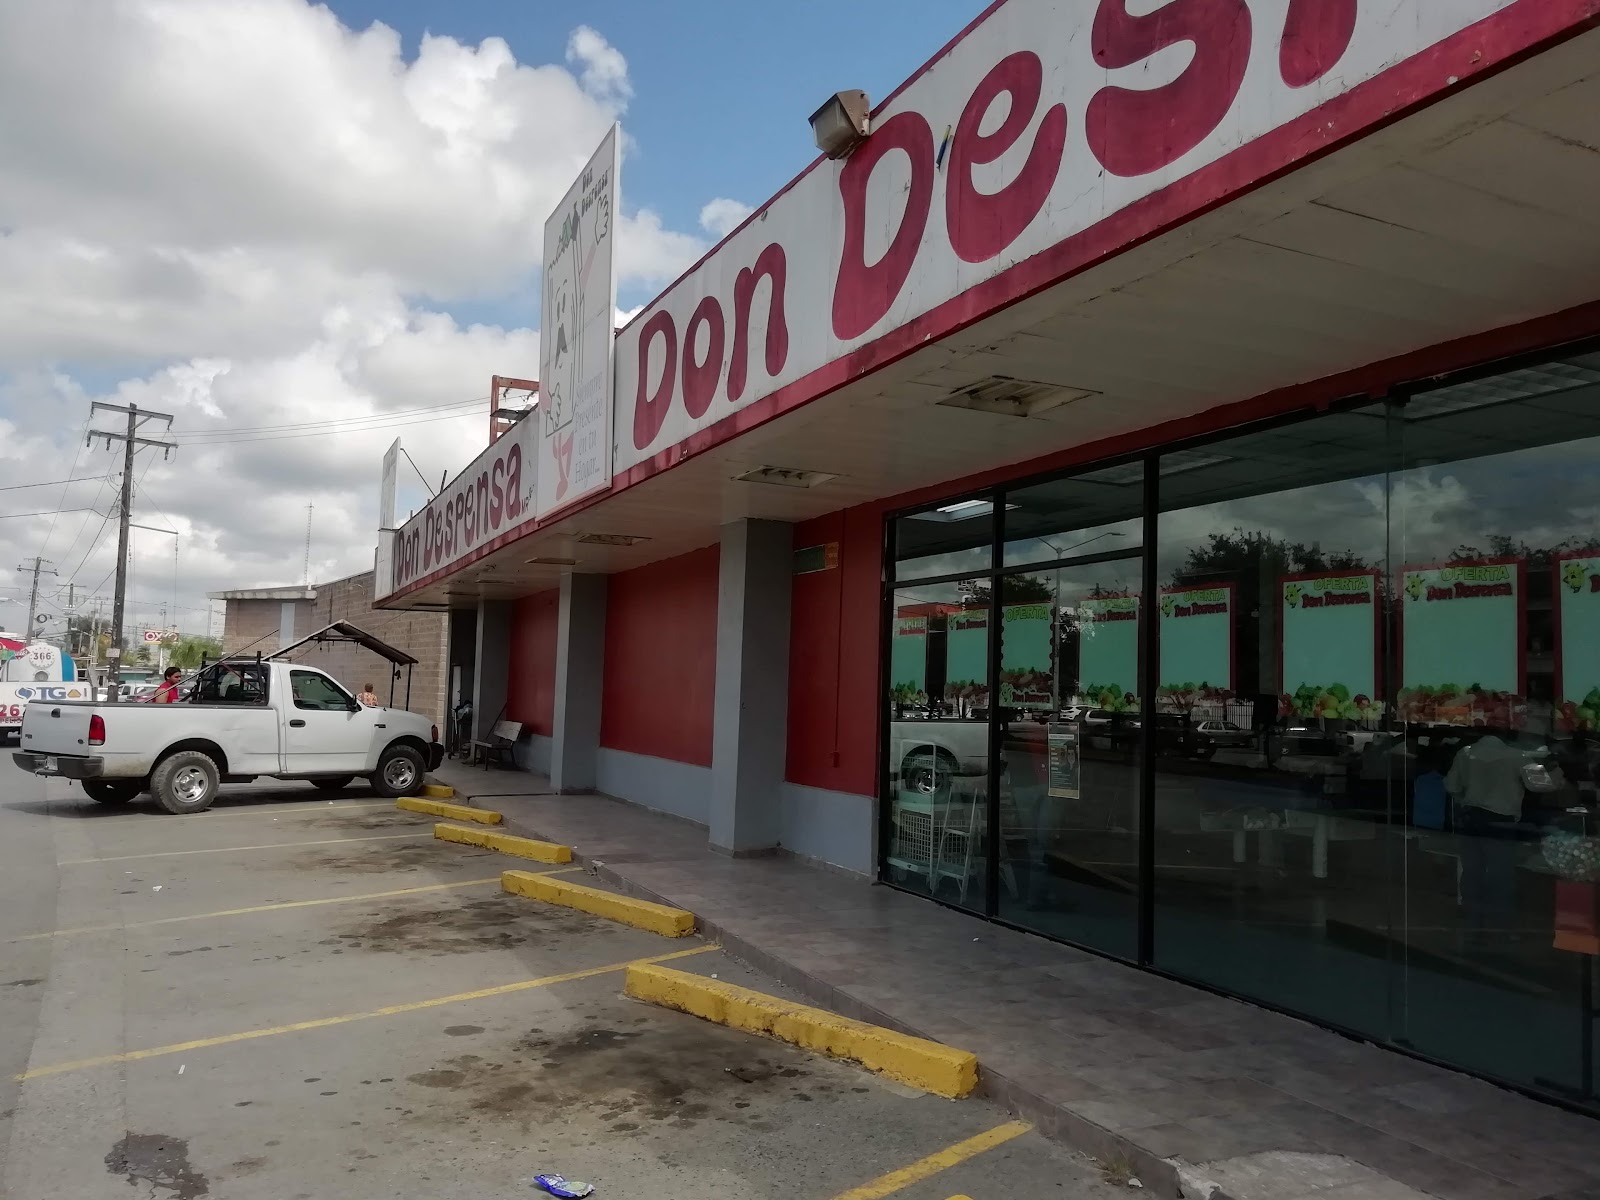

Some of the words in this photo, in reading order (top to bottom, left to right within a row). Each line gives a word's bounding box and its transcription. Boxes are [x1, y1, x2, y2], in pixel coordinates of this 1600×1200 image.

[632, 242, 788, 450] Don
[579, 436, 588, 456] en
[397, 527, 419, 586] Don
[424, 442, 522, 571] Despensa
[1441, 565, 1510, 582] OFERTA
[1313, 576, 1368, 591] OFERTA
[1183, 589, 1226, 602] OFERTA
[1005, 605, 1049, 622] OFERTA
[33, 652, 52, 660] 366
